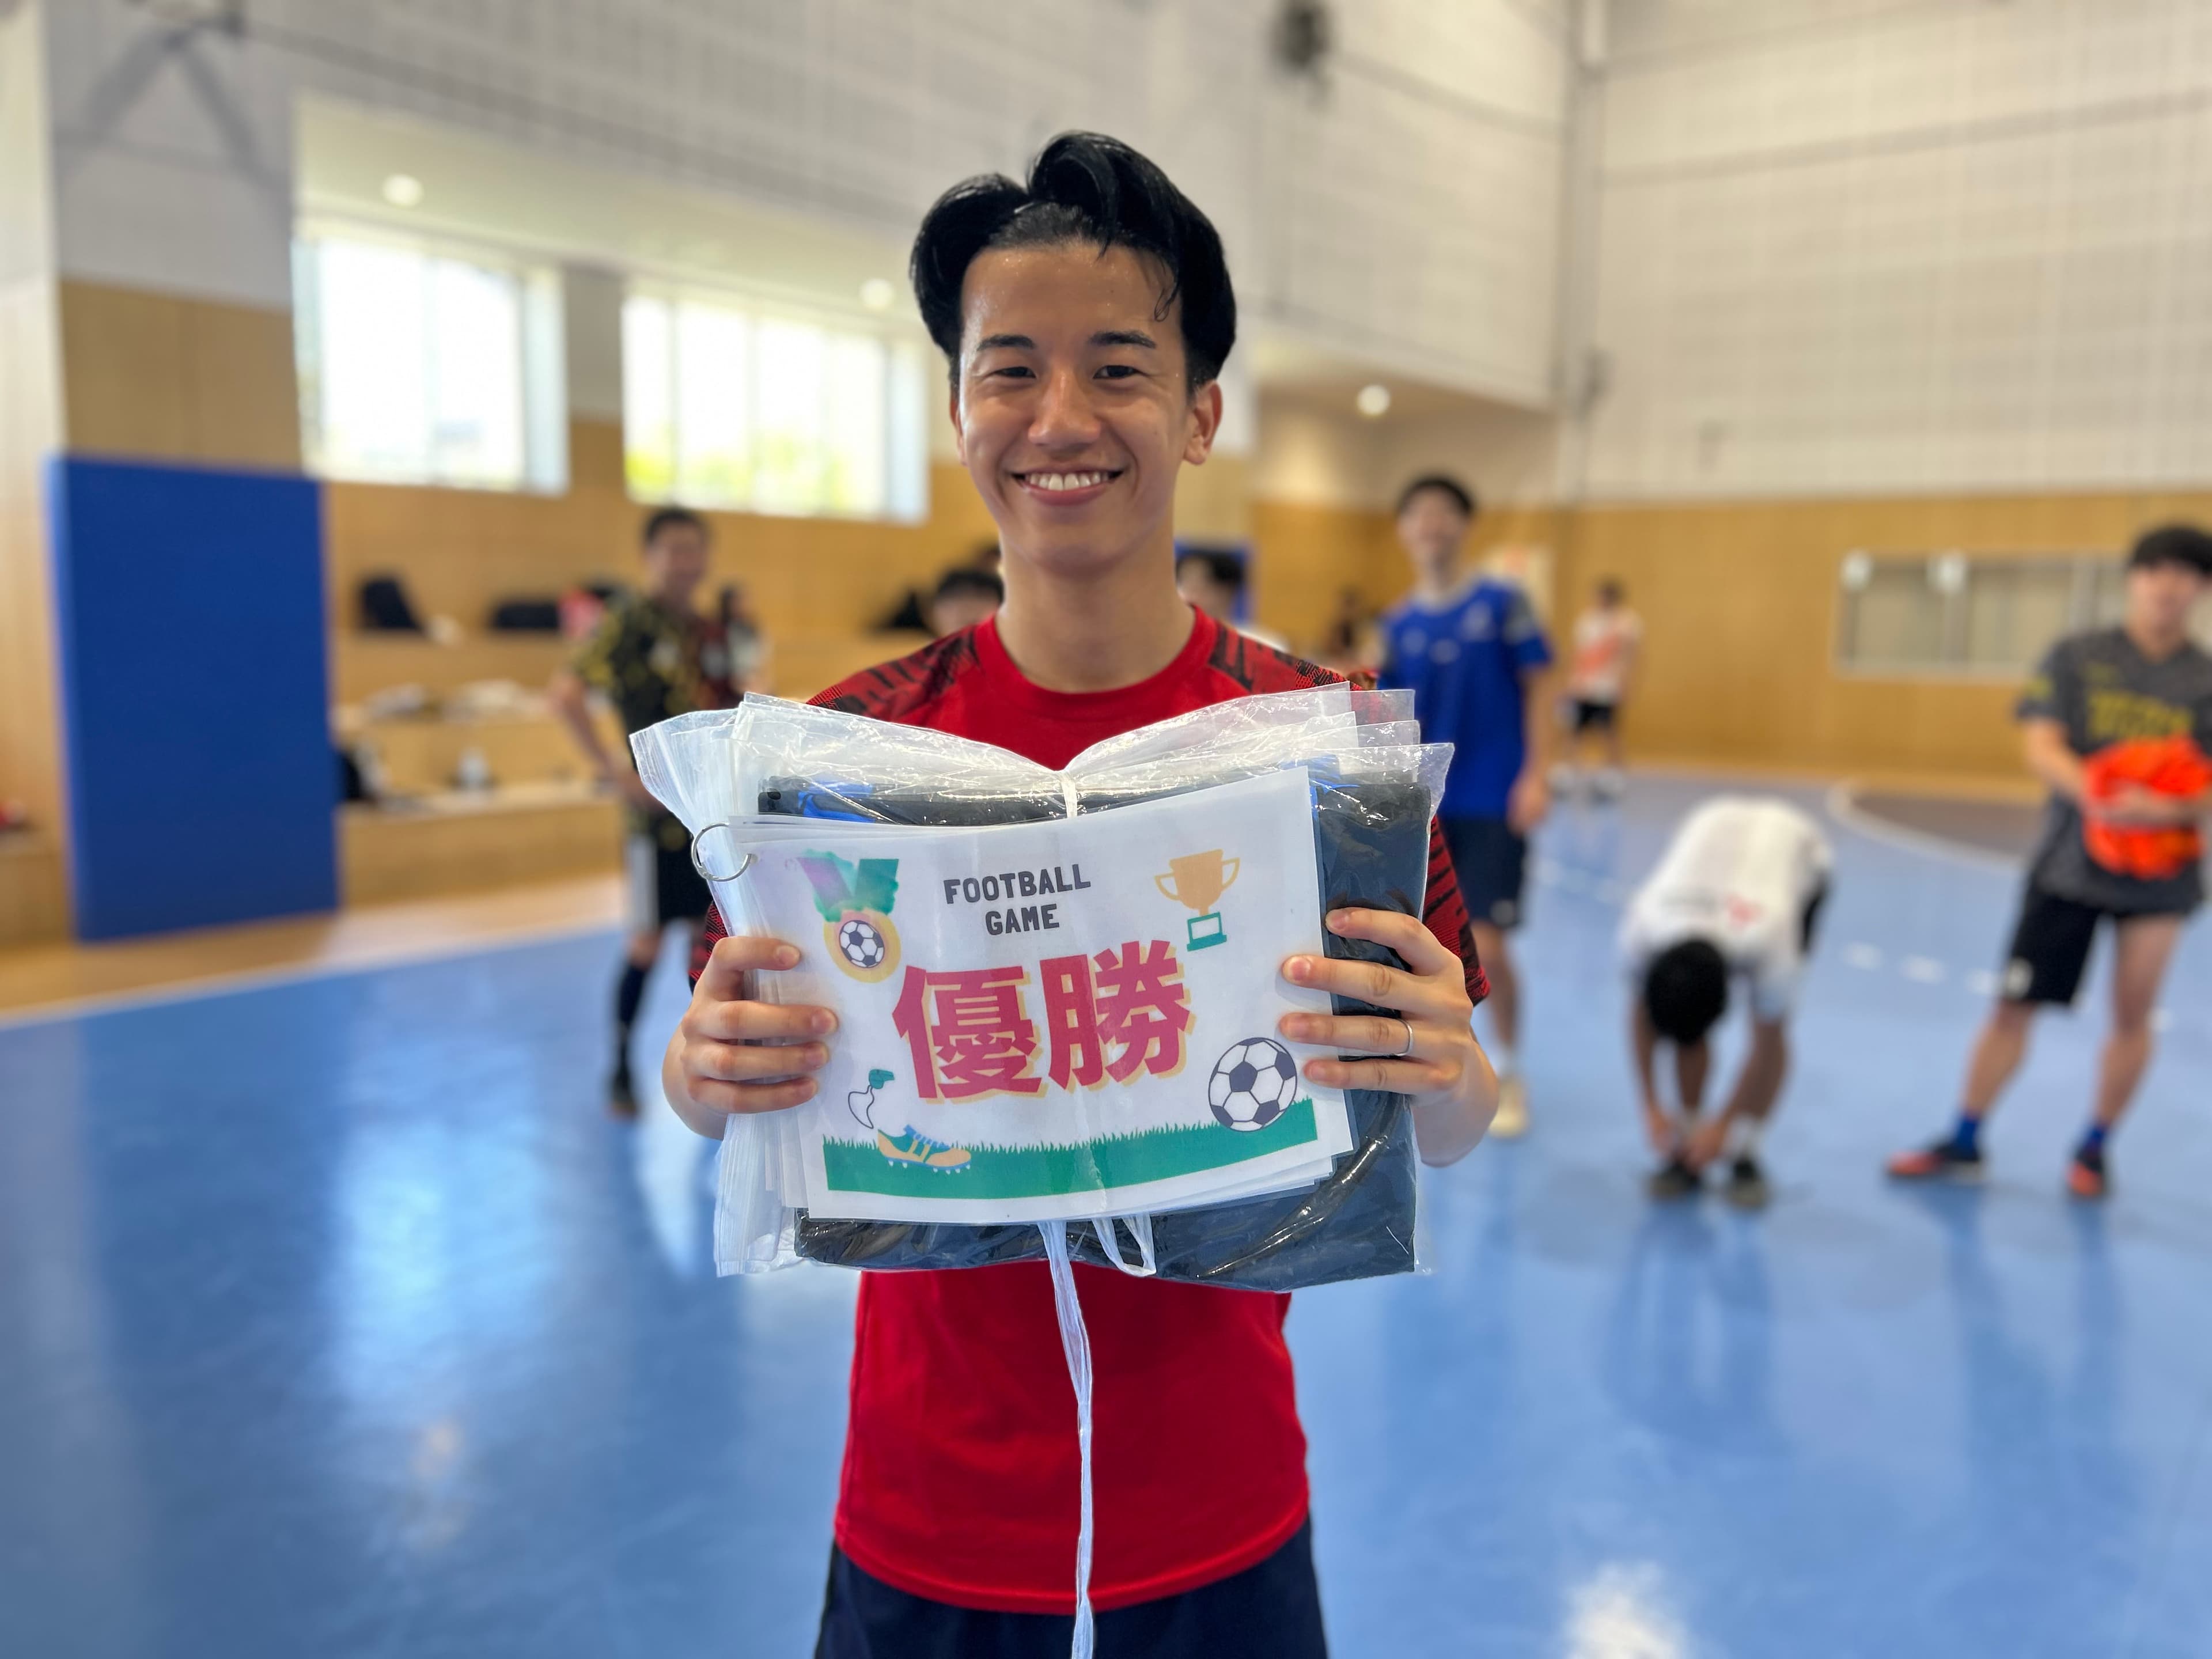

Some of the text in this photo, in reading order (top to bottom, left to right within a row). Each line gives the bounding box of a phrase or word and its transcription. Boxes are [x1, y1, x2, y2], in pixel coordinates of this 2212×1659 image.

[943, 863, 1091, 904] FOOTBALL
[985, 903, 1060, 935] GAME
[891, 940, 1194, 1101] 優勝
